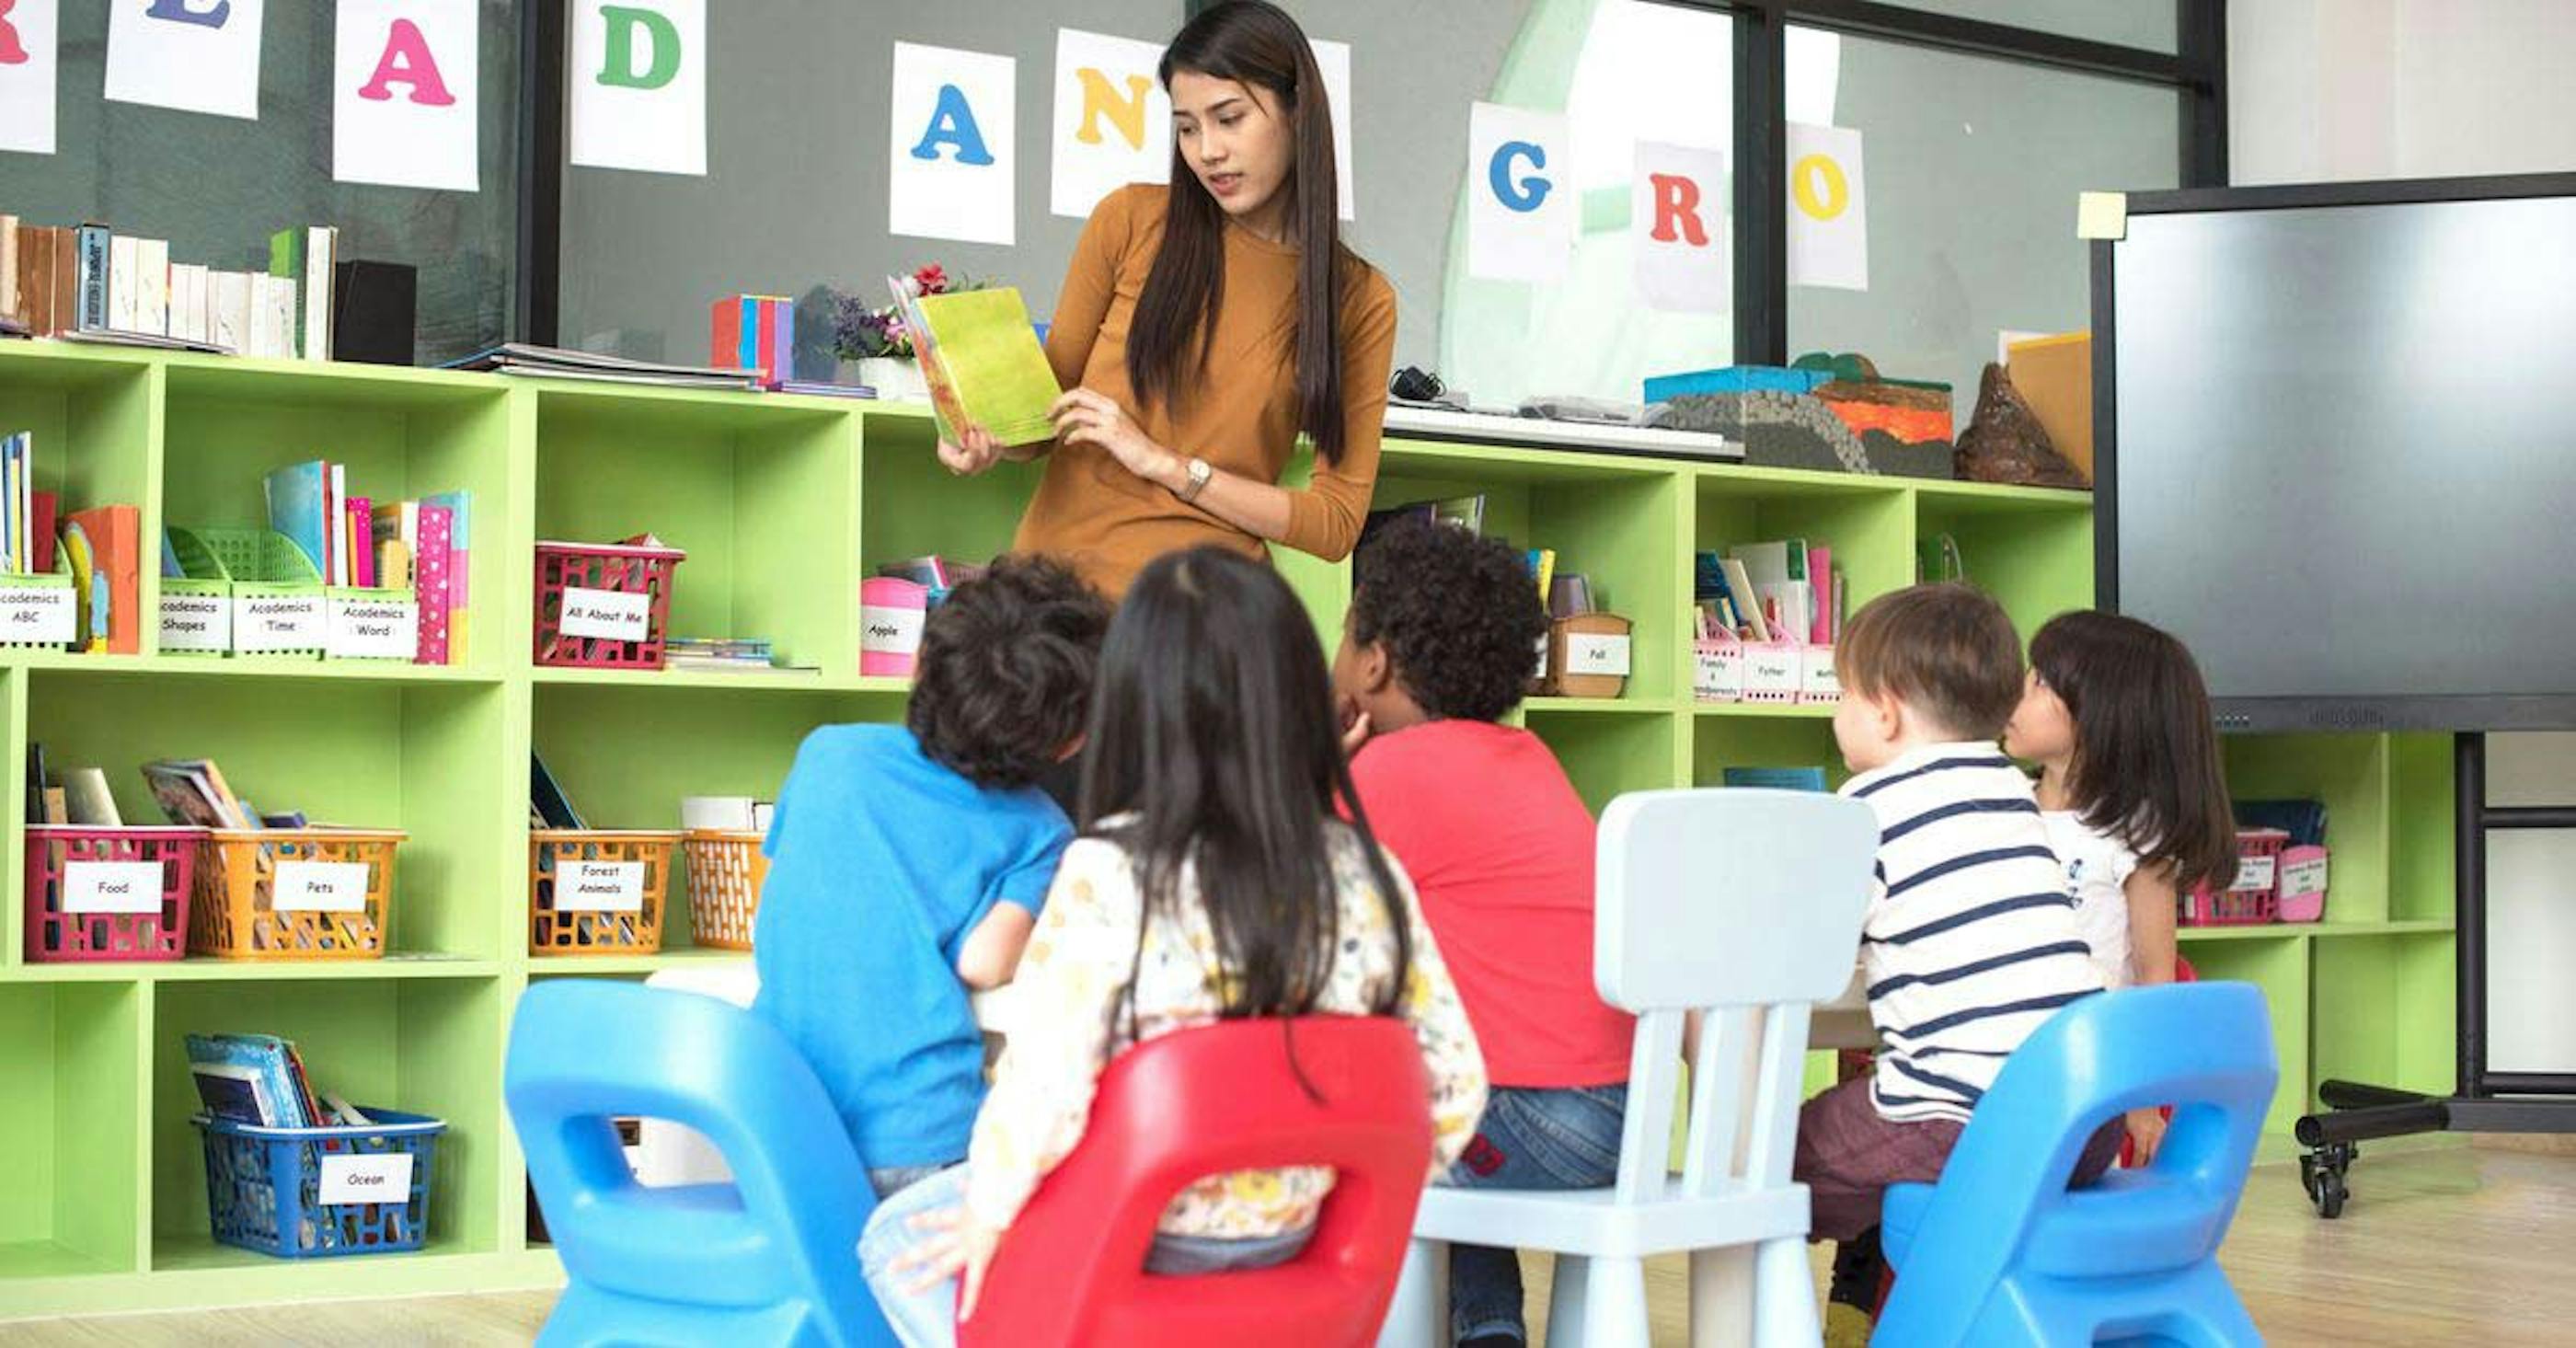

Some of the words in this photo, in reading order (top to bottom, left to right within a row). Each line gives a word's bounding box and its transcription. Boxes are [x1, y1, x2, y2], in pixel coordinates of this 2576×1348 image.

[595, 4, 682, 90] D
[358, 18, 456, 107] A
[1075, 67, 1153, 152] N
[910, 84, 995, 167] A
[1489, 141, 1553, 213] G
[1791, 153, 1849, 222] O
[1650, 172, 1710, 248] R
[0, 592, 61, 605] cademics
[160, 598, 218, 613] cademics
[248, 602, 313, 615] Academics
[342, 604, 405, 618] Academics
[12, 610, 40, 623] ABC
[566, 606, 583, 617] All
[587, 607, 621, 621] About
[625, 612, 642, 623] Me
[161, 617, 206, 633] Shapes
[266, 619, 296, 631] Time
[357, 625, 392, 636] Word
[868, 625, 899, 638] Apple
[581, 864, 620, 876] Forest
[98, 881, 130, 894] Food
[306, 881, 335, 894] Pets
[577, 883, 623, 894] Animals
[346, 1173, 385, 1186] Ocean
